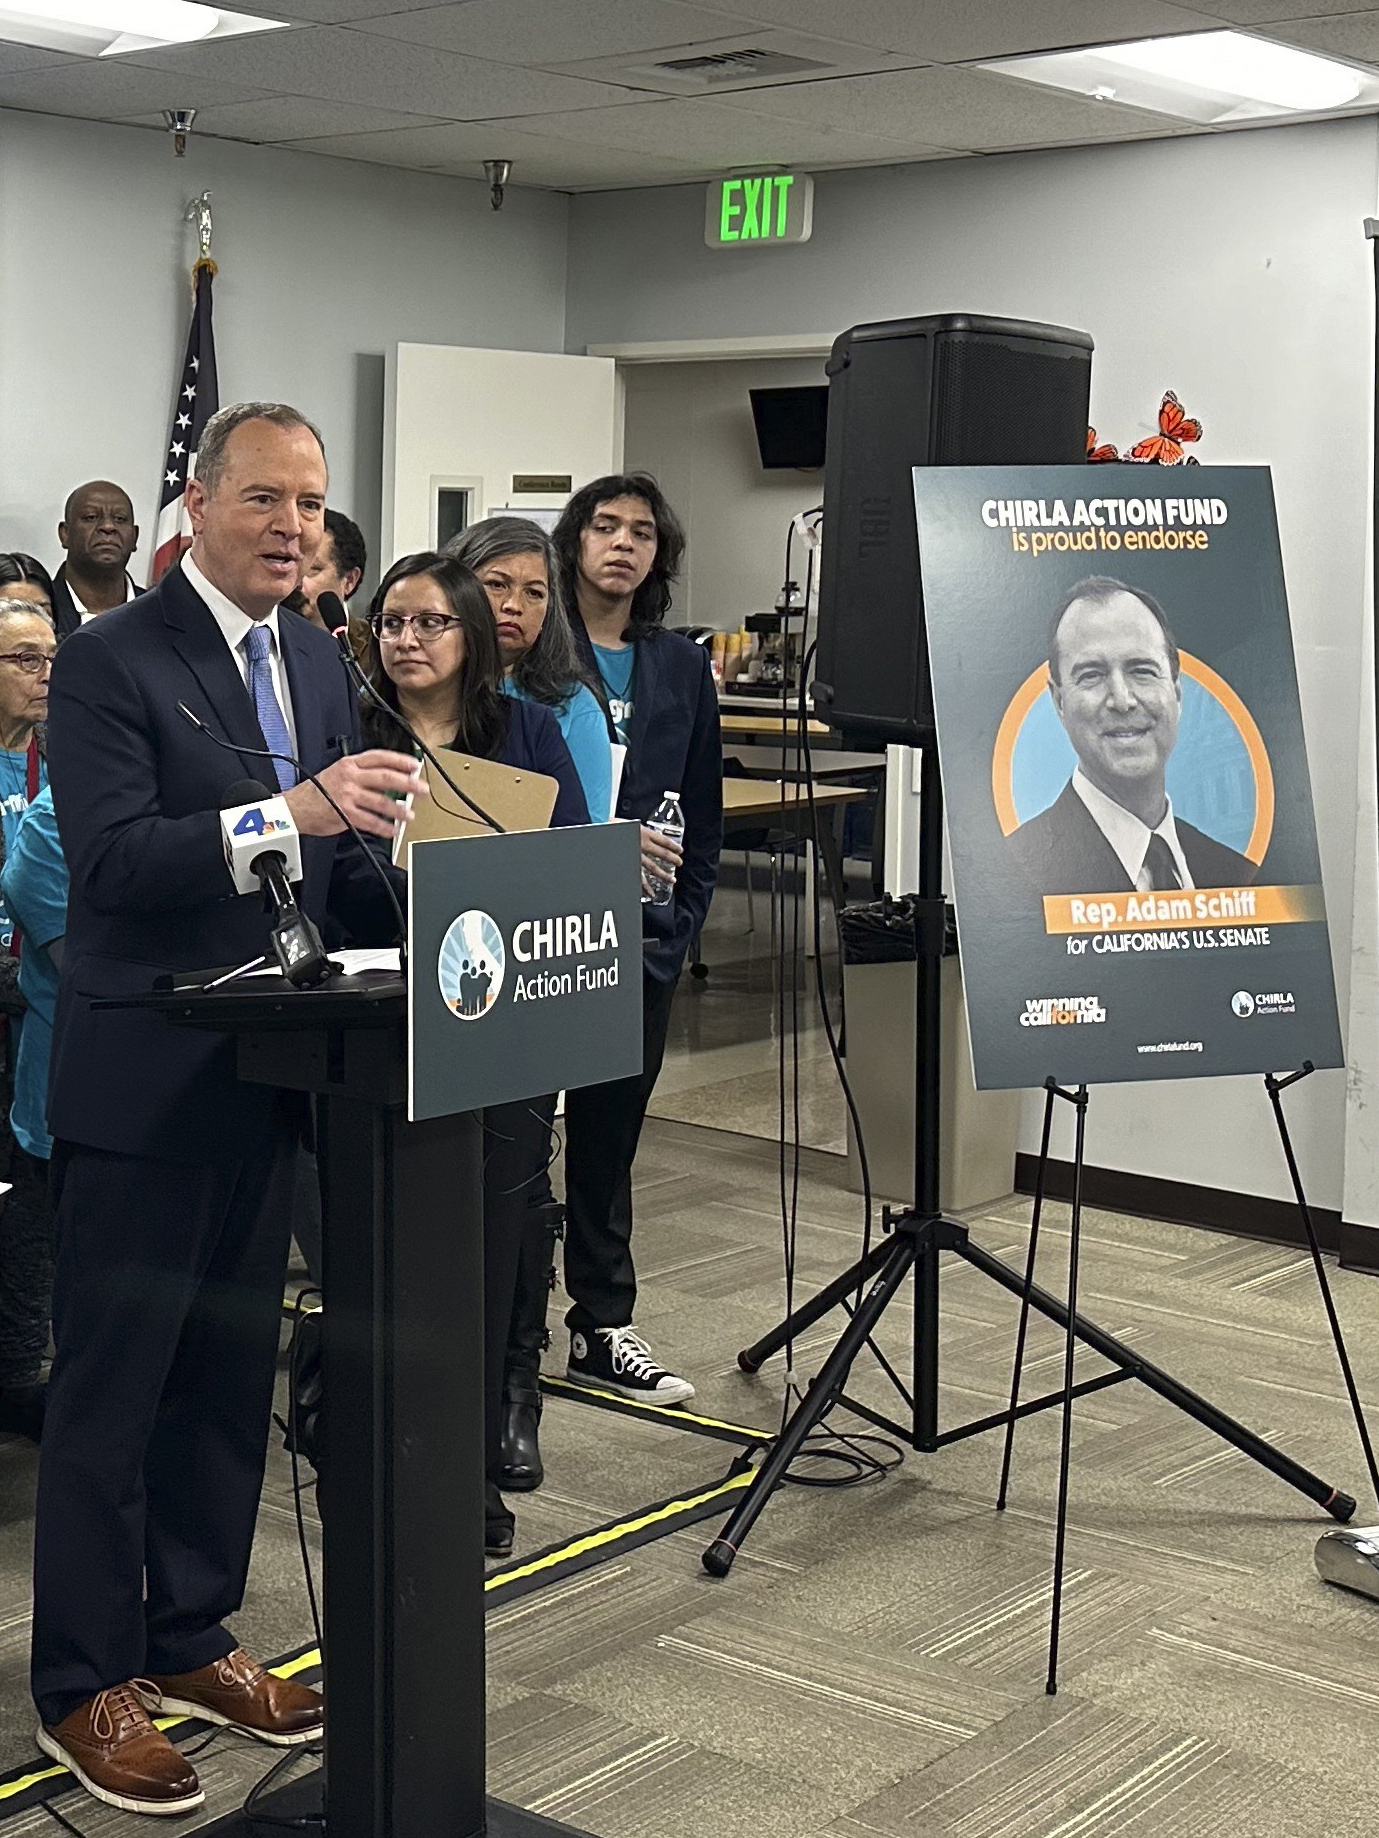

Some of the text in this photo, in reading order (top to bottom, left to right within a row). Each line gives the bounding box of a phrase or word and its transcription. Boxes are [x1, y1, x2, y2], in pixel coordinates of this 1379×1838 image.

[721, 175, 793, 241] EXIT
[981, 498, 1228, 527] CHIRLA ACTION FUND
[1012, 526, 1209, 557] is proud to endorse
[233, 808, 265, 836] 4
[1070, 890, 1256, 929] Rep. Adam Schiff
[512, 910, 619, 962] CHIRLA
[1066, 927, 1271, 955] for CALIFORNIA'S U.S. SENATE
[513, 958, 619, 1003] Action Fund
[1026, 996, 1098, 1013] winning
[1255, 993, 1295, 1005] CHIRLA
[1019, 1007, 1106, 1027] california
